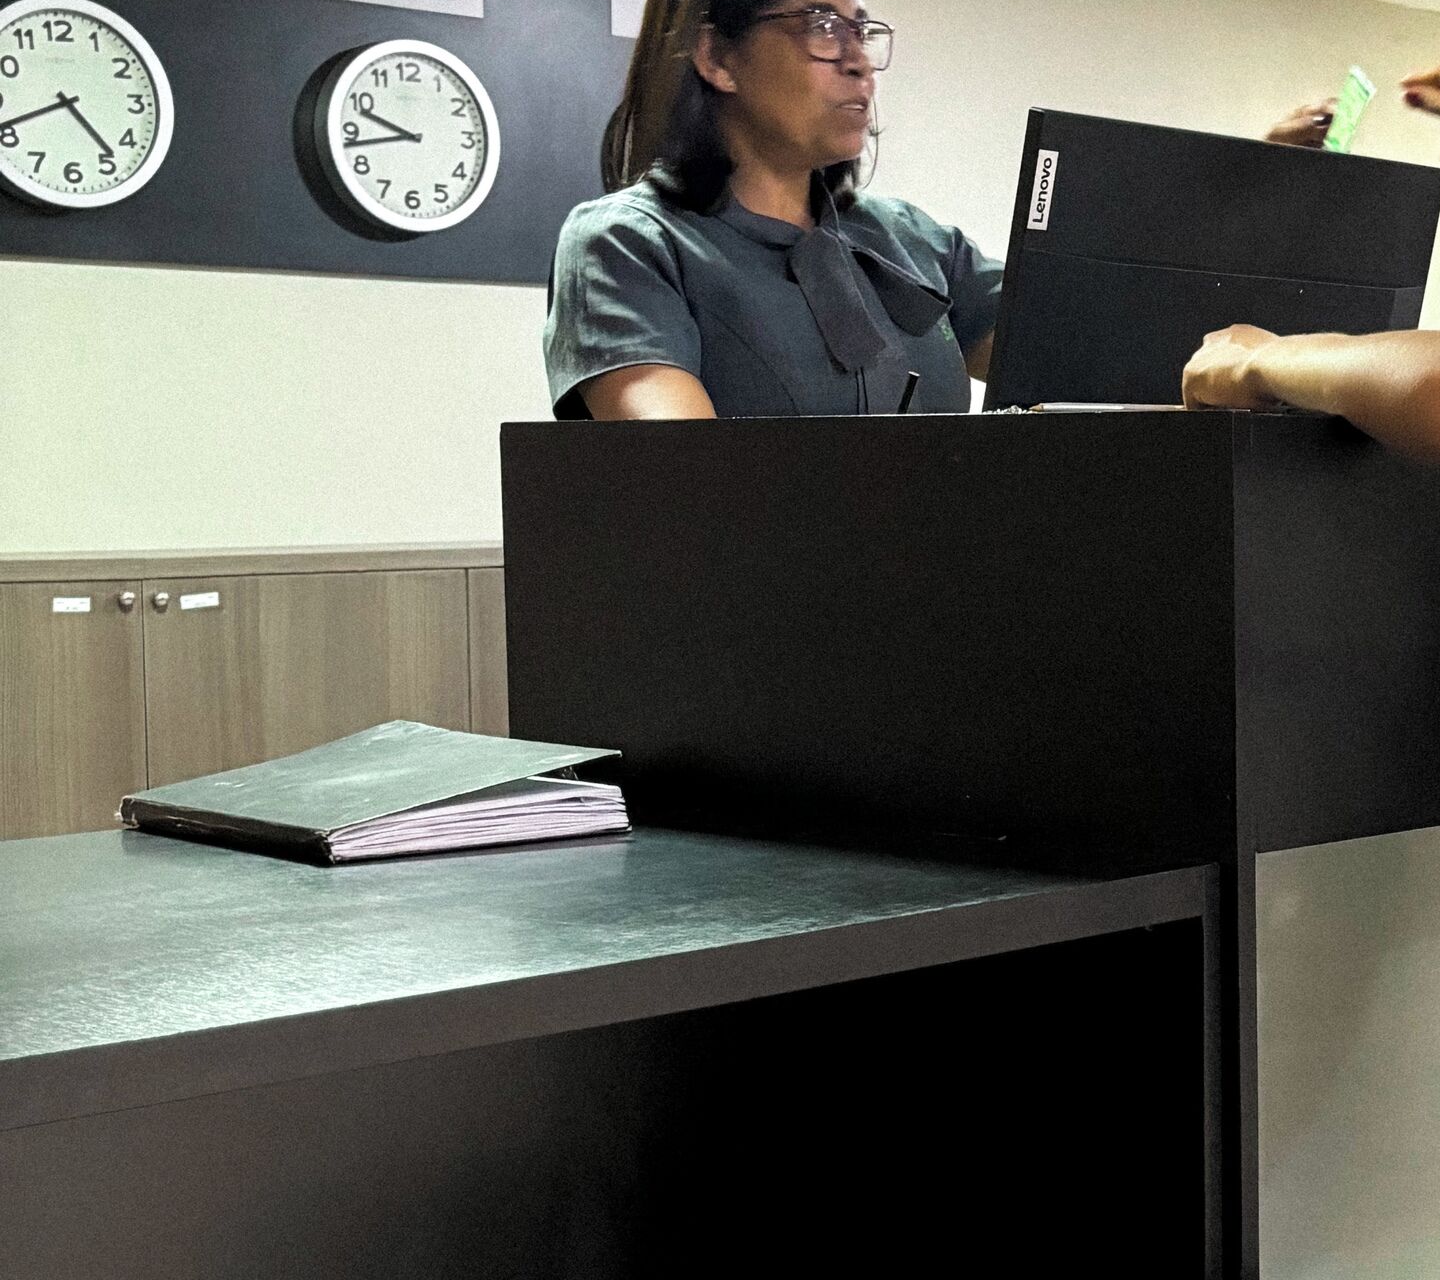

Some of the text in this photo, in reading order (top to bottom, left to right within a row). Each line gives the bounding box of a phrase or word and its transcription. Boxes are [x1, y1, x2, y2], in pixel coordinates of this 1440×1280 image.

[13, 28, 35, 50] 11
[42, 20, 74, 42] 12
[89, 32, 99, 52] 1
[112, 57, 132, 79] 2
[371, 68, 388, 88] 11
[396, 62, 421, 83] 12
[433, 75, 441, 93] 1
[127, 94, 145, 115] 3
[350, 92, 374, 113] 10
[450, 98, 467, 117] 2
[119, 128, 138, 149] 4
[343, 121, 360, 144] 9
[461, 131, 476, 150] 3
[27, 151, 46, 173] 7
[98, 153, 117, 175] 5
[353, 155, 370, 175] 8
[451, 161, 467, 181] 4
[63, 162, 83, 184] 6
[377, 179, 392, 199] 7
[433, 183, 449, 204] 5
[1032, 157, 1052, 223] Lenovo
[404, 190, 421, 210] 6
